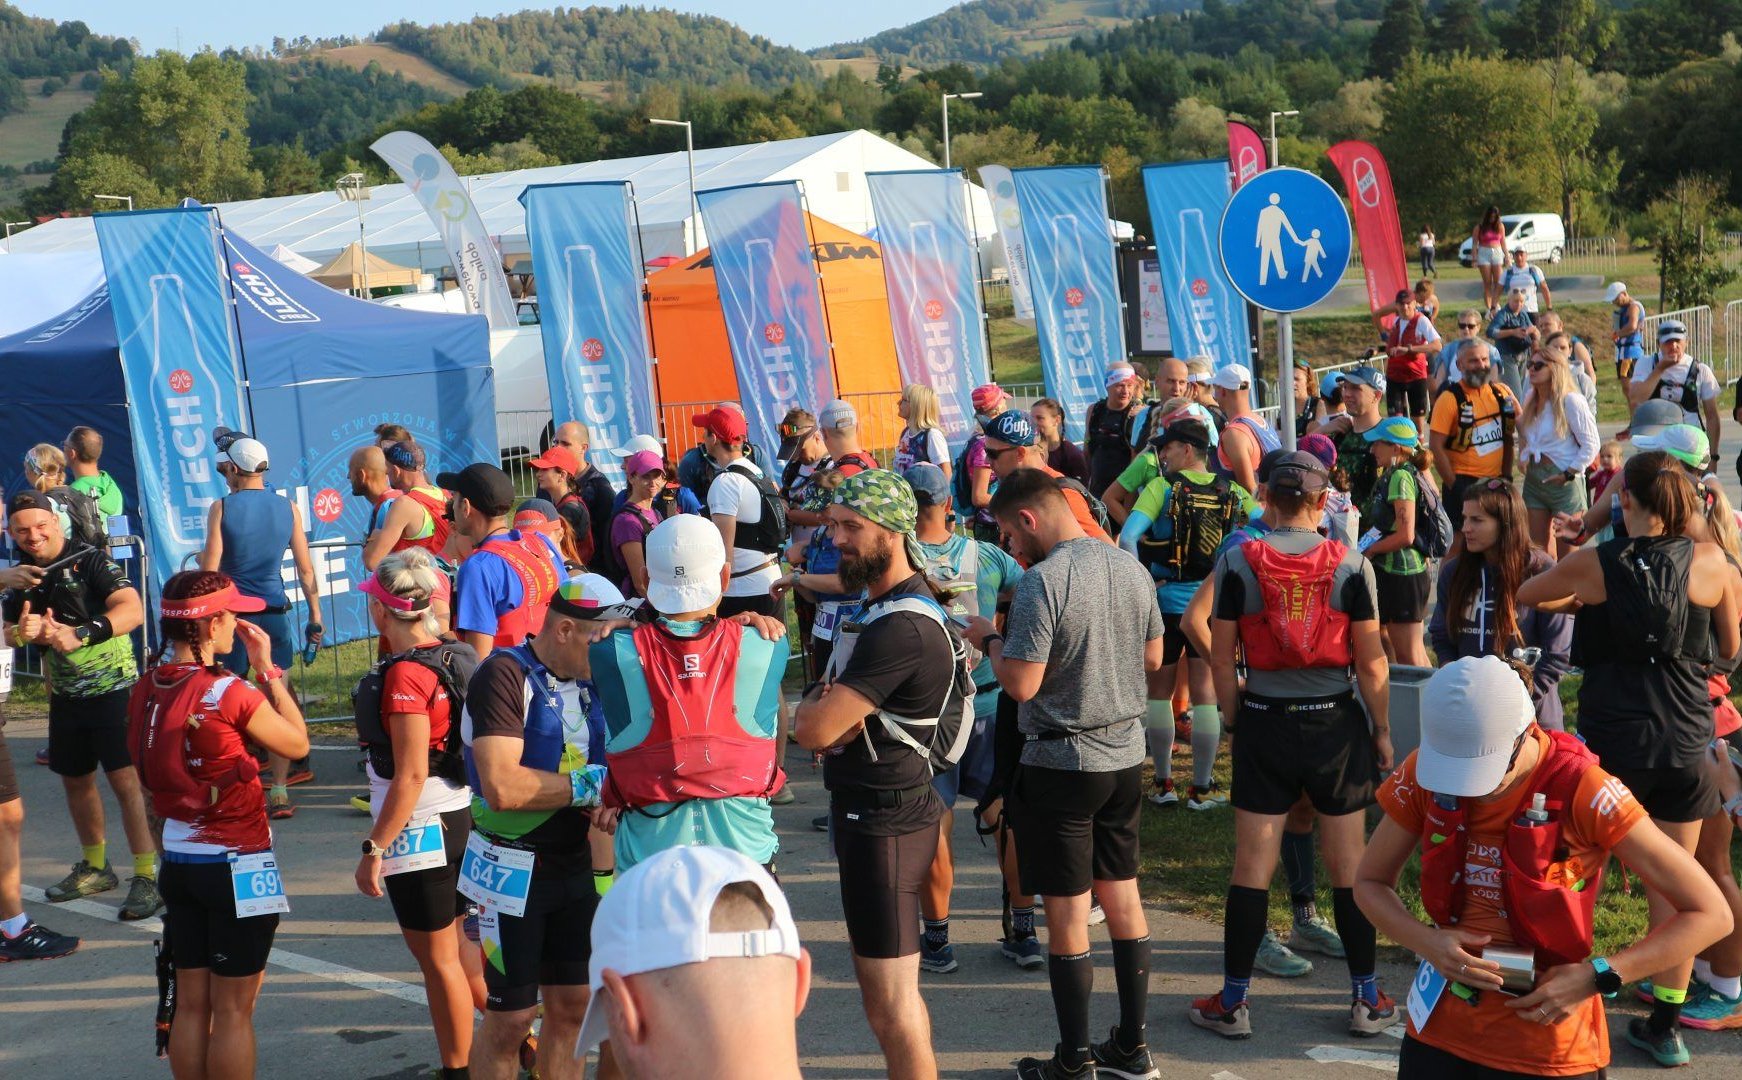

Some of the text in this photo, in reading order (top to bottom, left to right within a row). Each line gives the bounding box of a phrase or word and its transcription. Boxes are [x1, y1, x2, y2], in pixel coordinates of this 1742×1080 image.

[238, 274, 298, 314] LECH
[1003, 415, 1029, 437] Buff
[1299, 702, 1336, 711] ICEBUG
[470, 856, 513, 892] 647
